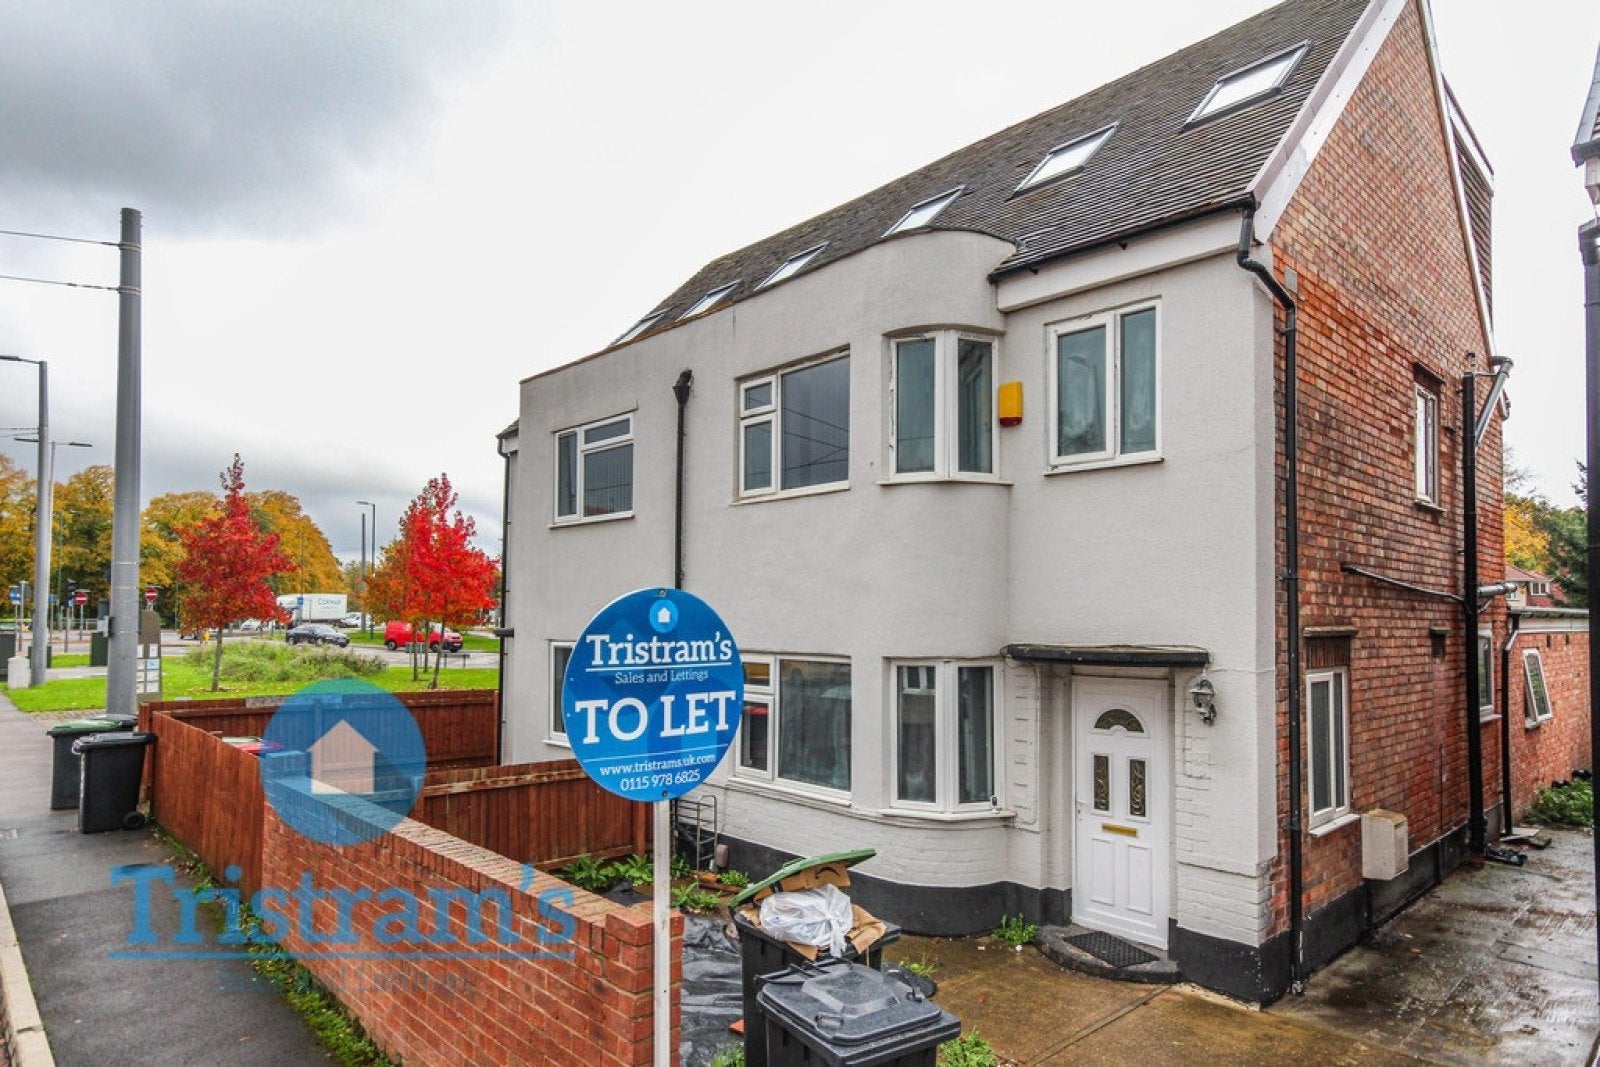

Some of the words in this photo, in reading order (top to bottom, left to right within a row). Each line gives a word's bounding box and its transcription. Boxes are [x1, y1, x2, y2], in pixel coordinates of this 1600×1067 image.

[586, 631, 733, 666] Tristram's
[615, 671, 645, 684] Sales
[646, 670, 668, 682] and
[670, 668, 709, 682] Lettings
[575, 697, 648, 744] TO
[660, 690, 737, 738] LET
[600, 754, 717, 776] www.tristrams.uk.com
[621, 777, 649, 791] 0115
[651, 772, 673, 788] 978
[674, 768, 701, 785] 6825
